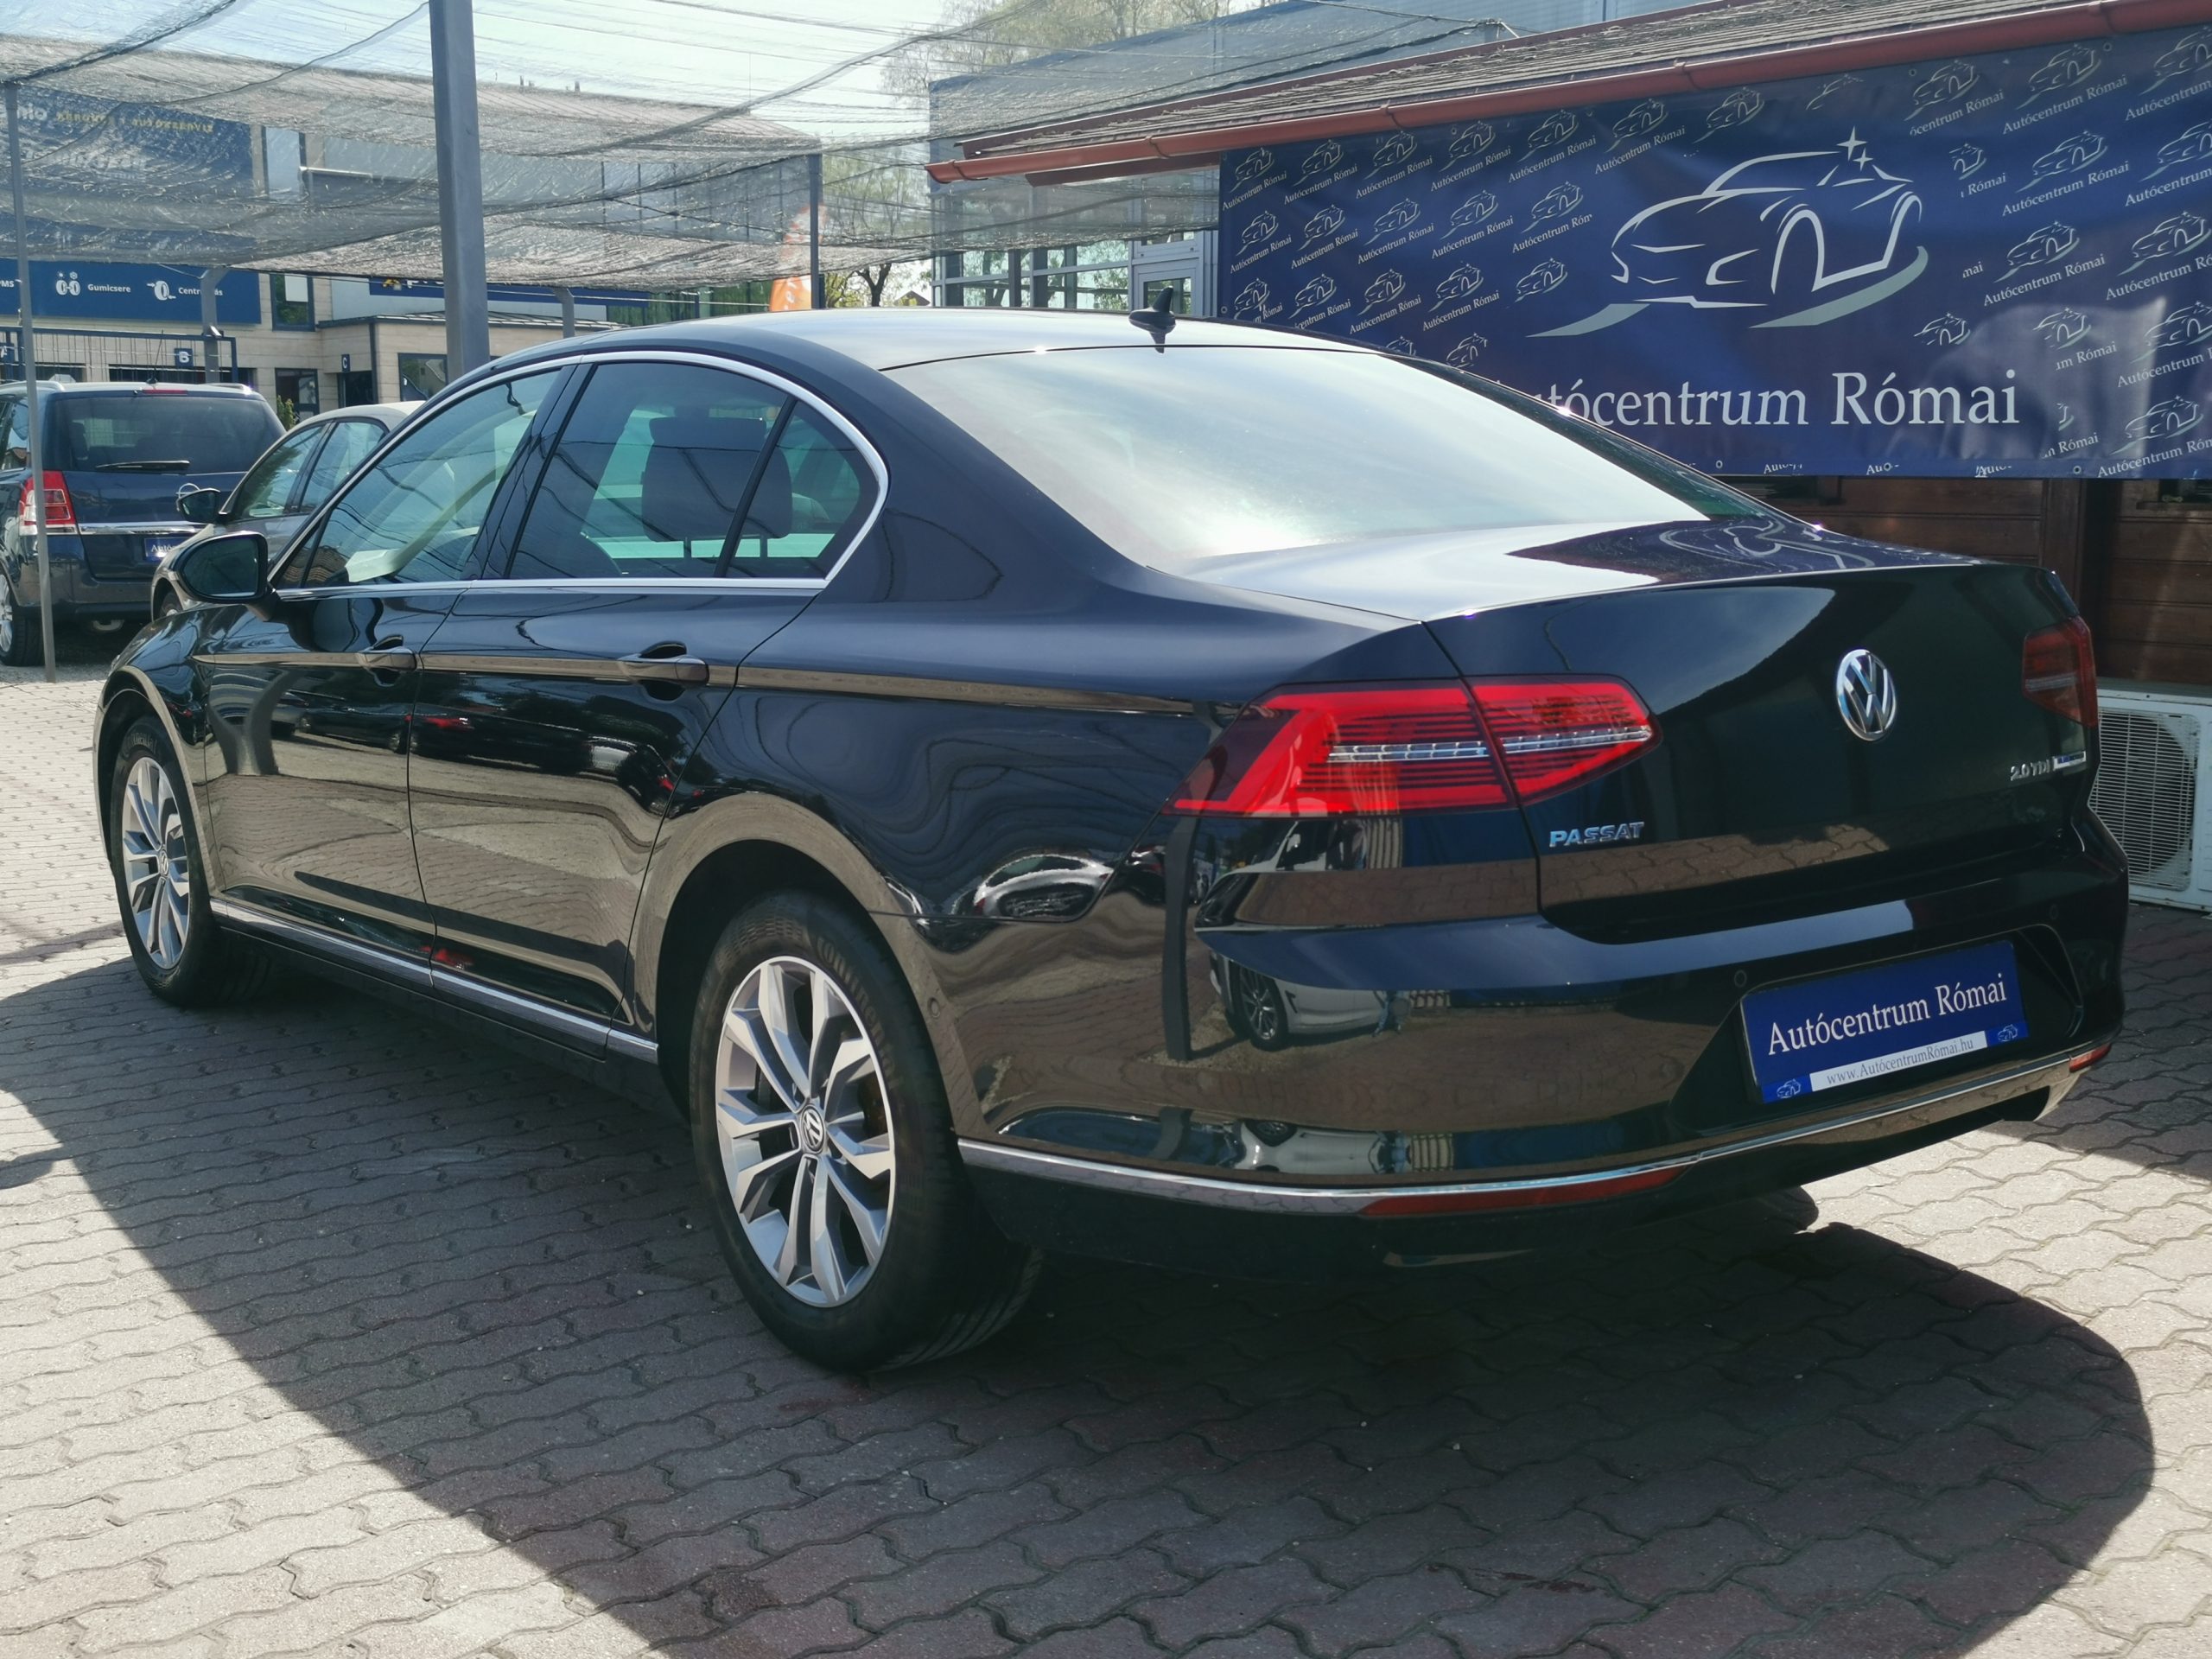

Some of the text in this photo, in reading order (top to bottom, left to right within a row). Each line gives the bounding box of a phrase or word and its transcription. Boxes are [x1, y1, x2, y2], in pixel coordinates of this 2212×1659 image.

[1966, 90, 2005, 113] Római
[2003, 74, 2128, 135] Autócentrum Római
[2125, 80, 2212, 121] Autócentrum
[1430, 145, 1511, 192] Autócentrum Római
[1509, 135, 1597, 182] Autócentrum Római
[1595, 125, 1685, 175] Autócentrum Római
[1223, 171, 1287, 211] Autócentrum Római
[1284, 163, 1357, 205] Autócentrum Római
[1356, 155, 1433, 199] Autócentrum Római
[1968, 173, 2006, 195] Római
[2002, 161, 2129, 216] Autócentrum Római
[2125, 168, 2212, 207] Autócentrum
[1230, 234, 1292, 274] Autócentrum Római
[1291, 228, 1358, 270] Autócentrum Római
[1358, 223, 1434, 264] Autócentrum Római
[1432, 215, 1514, 259] Autócentrum Római
[1512, 222, 1569, 253] Autócentrum
[87, 283, 131, 293] Gumicsere
[178, 287, 223, 296] Centrás
[1983, 253, 2106, 307] Autócentrum Római
[2106, 264, 2192, 301] Autócentrum
[1327, 299, 1351, 316] Római
[1350, 295, 1421, 334] Autócentrum Római
[1423, 290, 1500, 331] Autócentrum Római
[179, 351, 189, 364] B
[2076, 341, 2117, 364] Római
[2118, 353, 2204, 387] Autócentrum
[1535, 369, 2019, 426] tócentrum Római
[2058, 432, 2099, 454] Római
[2097, 447, 2183, 478] Autócentrum
[2030, 759, 2050, 776] TDI
[1549, 822, 1644, 848] PASSAT
[1768, 973, 2006, 1055] Autócentrum Római
[1826, 1038, 1974, 1085] www.AutócentrumRómai.hu
